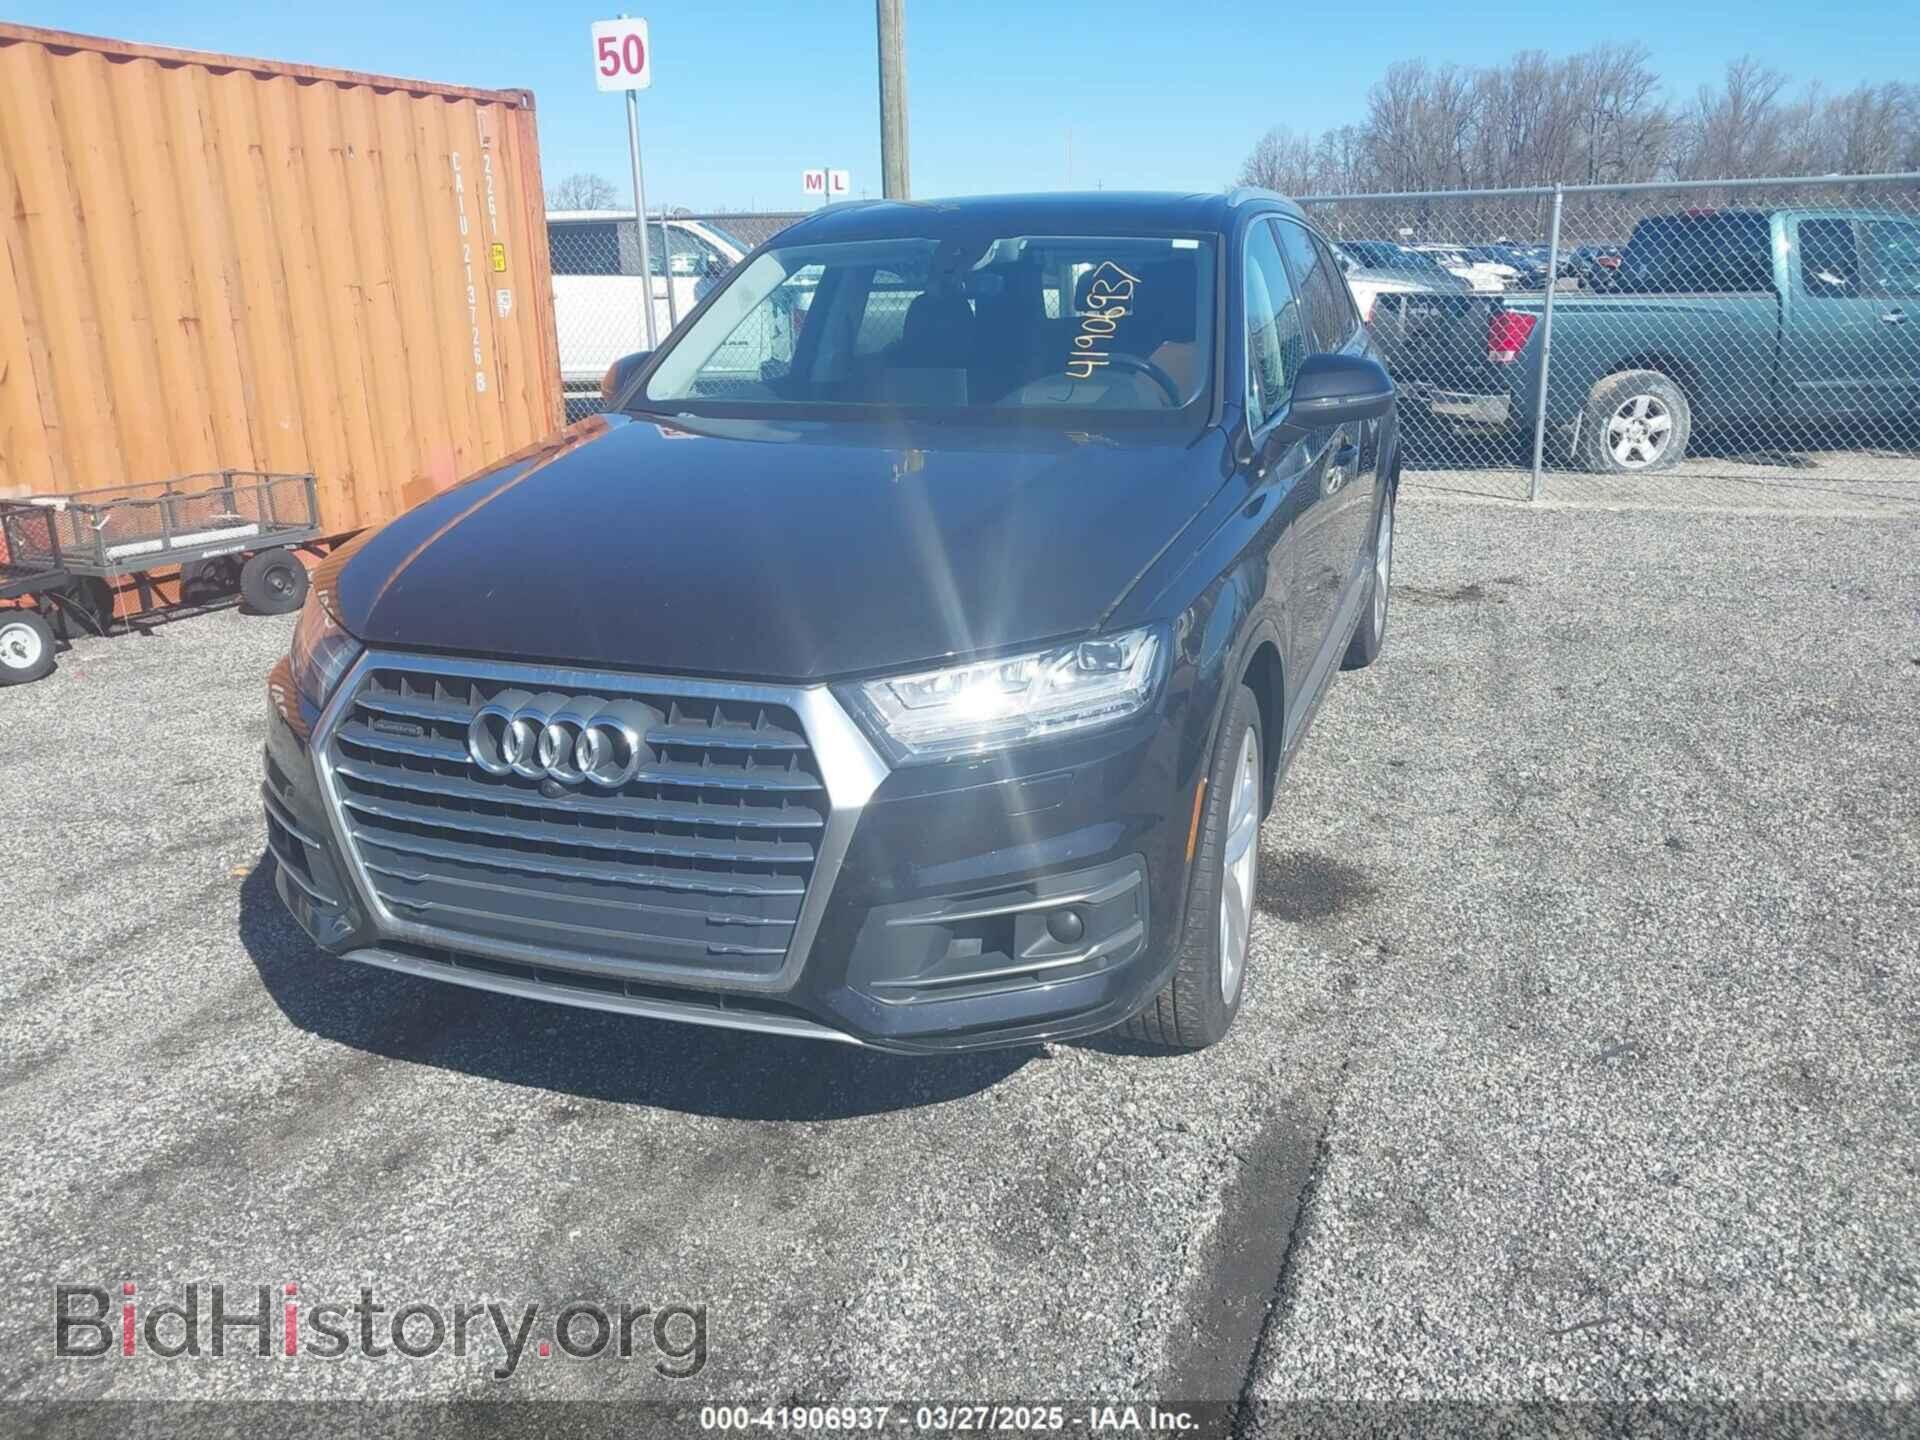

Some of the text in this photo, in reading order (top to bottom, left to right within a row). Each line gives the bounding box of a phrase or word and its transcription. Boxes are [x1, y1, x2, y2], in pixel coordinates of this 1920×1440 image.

[597, 33, 645, 77] 50
[805, 173, 823, 190] M
[834, 174, 844, 190] L
[451, 151, 468, 236] CAIU
[463, 243, 482, 366] 213726
